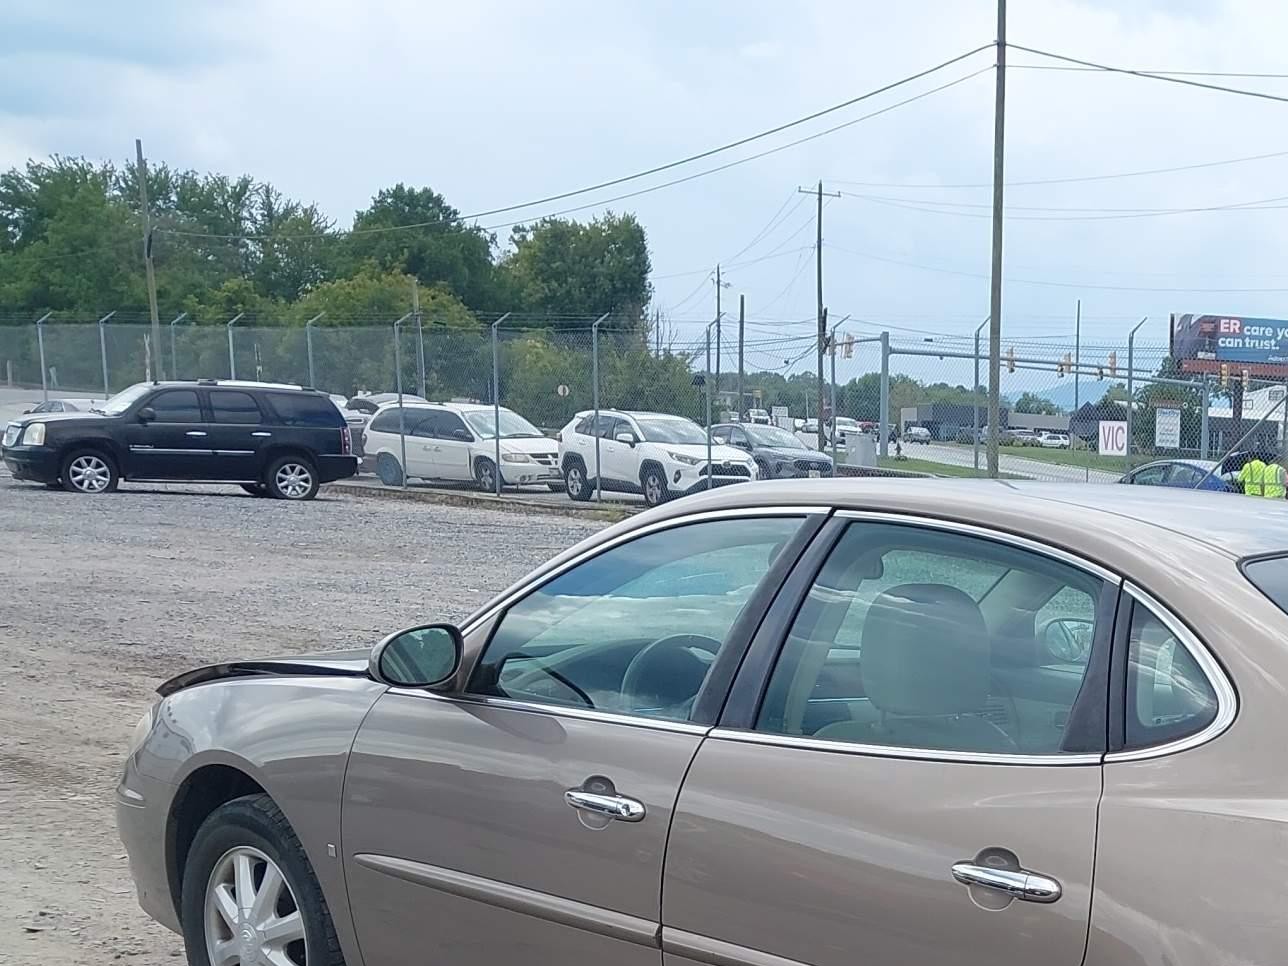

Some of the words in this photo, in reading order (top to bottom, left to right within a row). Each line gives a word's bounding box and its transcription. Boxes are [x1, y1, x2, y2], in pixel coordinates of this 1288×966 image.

[1220, 319, 1241, 334] ER
[1243, 324, 1274, 337] care
[1218, 336, 1243, 348] can
[1245, 337, 1280, 350] trust.
[1102, 425, 1125, 452] VIC
